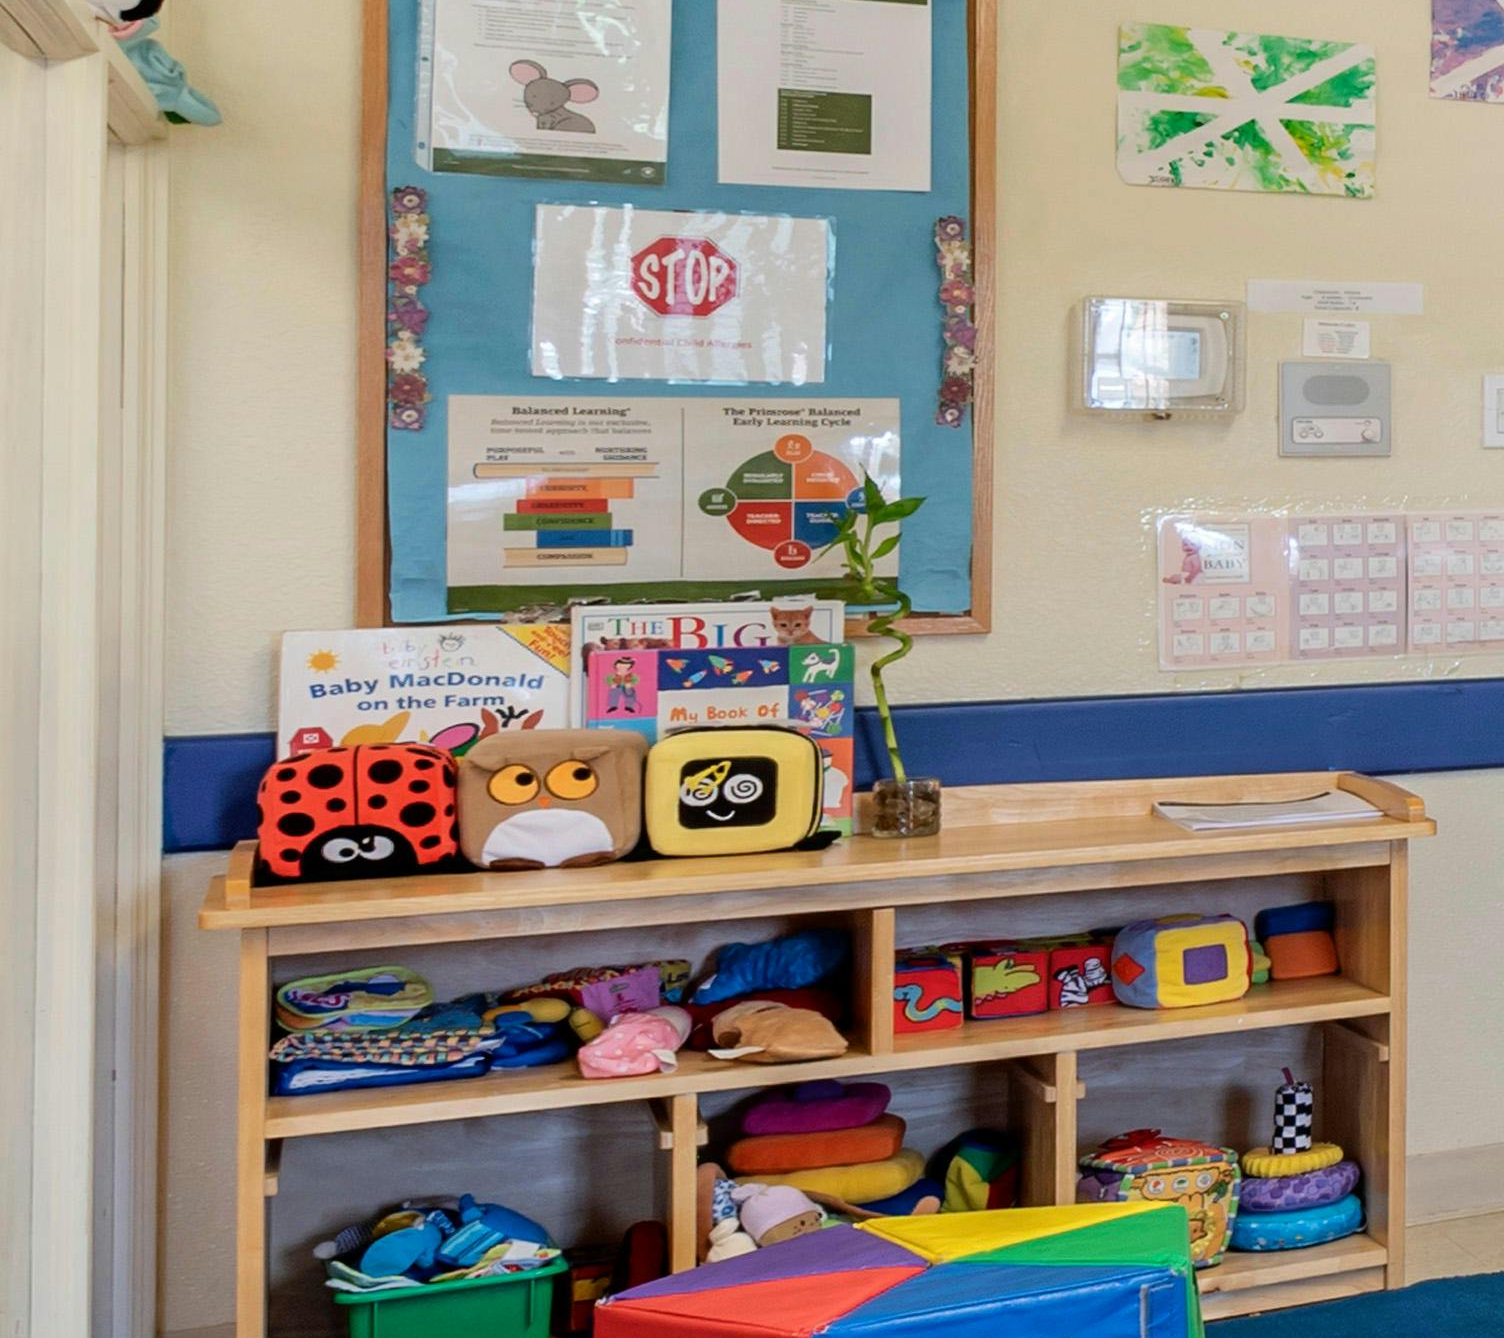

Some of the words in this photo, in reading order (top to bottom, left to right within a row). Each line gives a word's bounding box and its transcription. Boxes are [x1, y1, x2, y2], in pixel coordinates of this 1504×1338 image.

[637, 248, 731, 306] STOP
[511, 406, 569, 416] Balanced
[722, 407, 747, 416] The
[807, 407, 861, 417] Balanced
[732, 417, 763, 428] Early
[766, 417, 819, 428] Learning
[820, 417, 852, 428] Cycle
[607, 617, 665, 638] THE
[666, 615, 772, 650] BIG
[309, 677, 379, 700] Baby
[389, 671, 545, 691] MacDonald
[356, 699, 389, 712] on
[396, 696, 437, 710] the
[444, 694, 505, 709] Farm
[669, 706, 699, 723] My
[706, 706, 748, 721] Book
